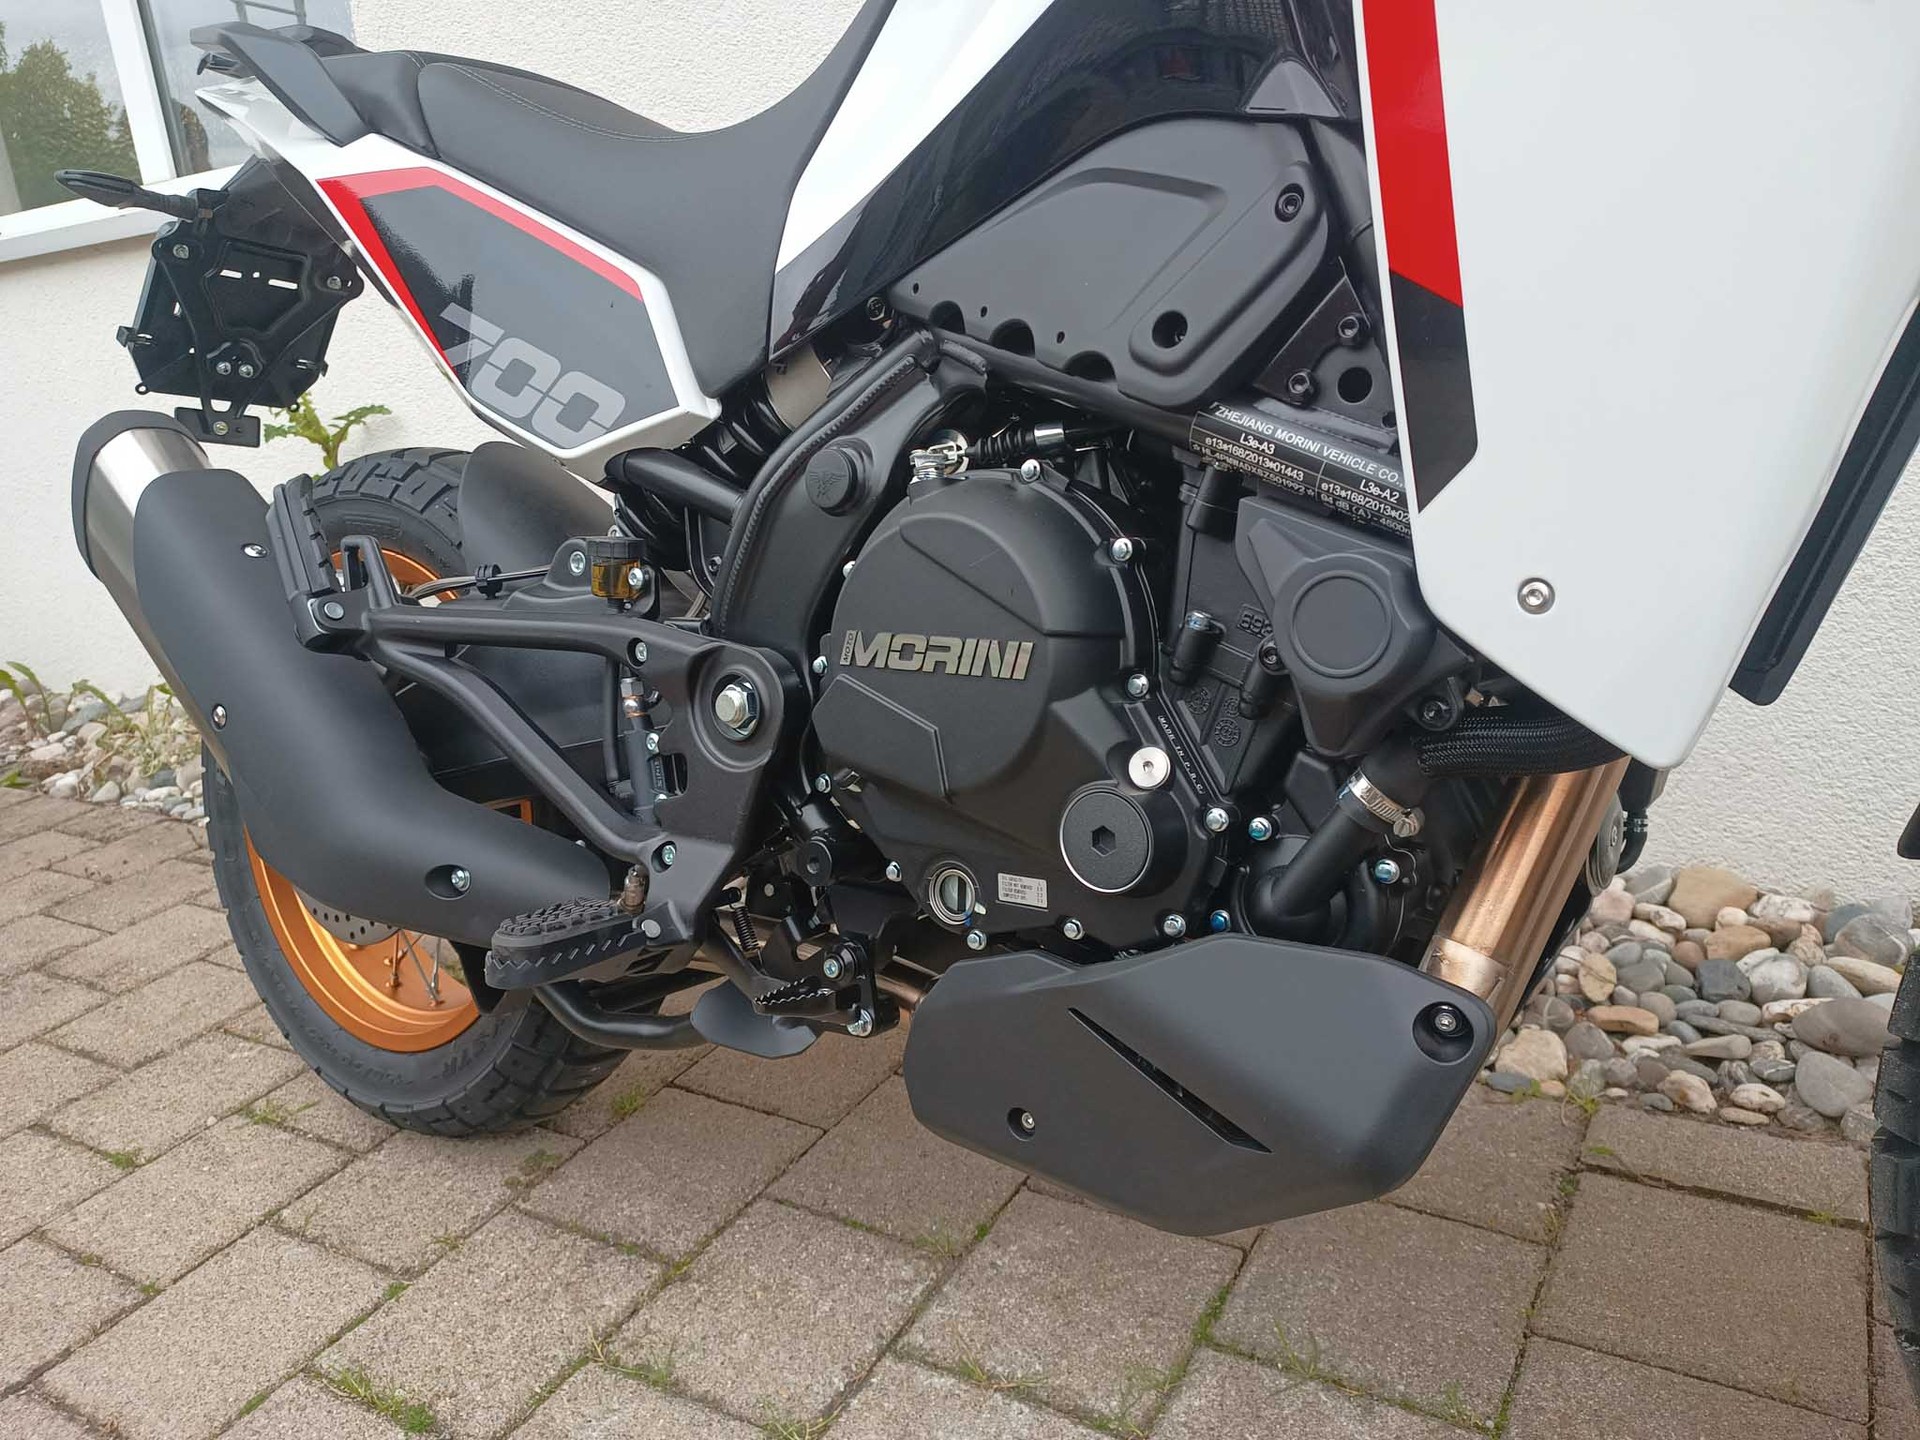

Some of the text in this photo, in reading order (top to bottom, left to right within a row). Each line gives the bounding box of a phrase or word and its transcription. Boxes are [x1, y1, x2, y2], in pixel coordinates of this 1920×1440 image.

[440, 302, 626, 449] 700
[1215, 406, 1274, 435] ZHEJIANG
[1275, 429, 1320, 453] MORINI
[1323, 446, 1377, 475] VEHICLE
[1240, 433, 1275, 454] L3e-A3
[1321, 482, 1410, 524] e13168/201302
[1360, 479, 1400, 503] L3e-A2
[853, 629, 1034, 680] MORINI
